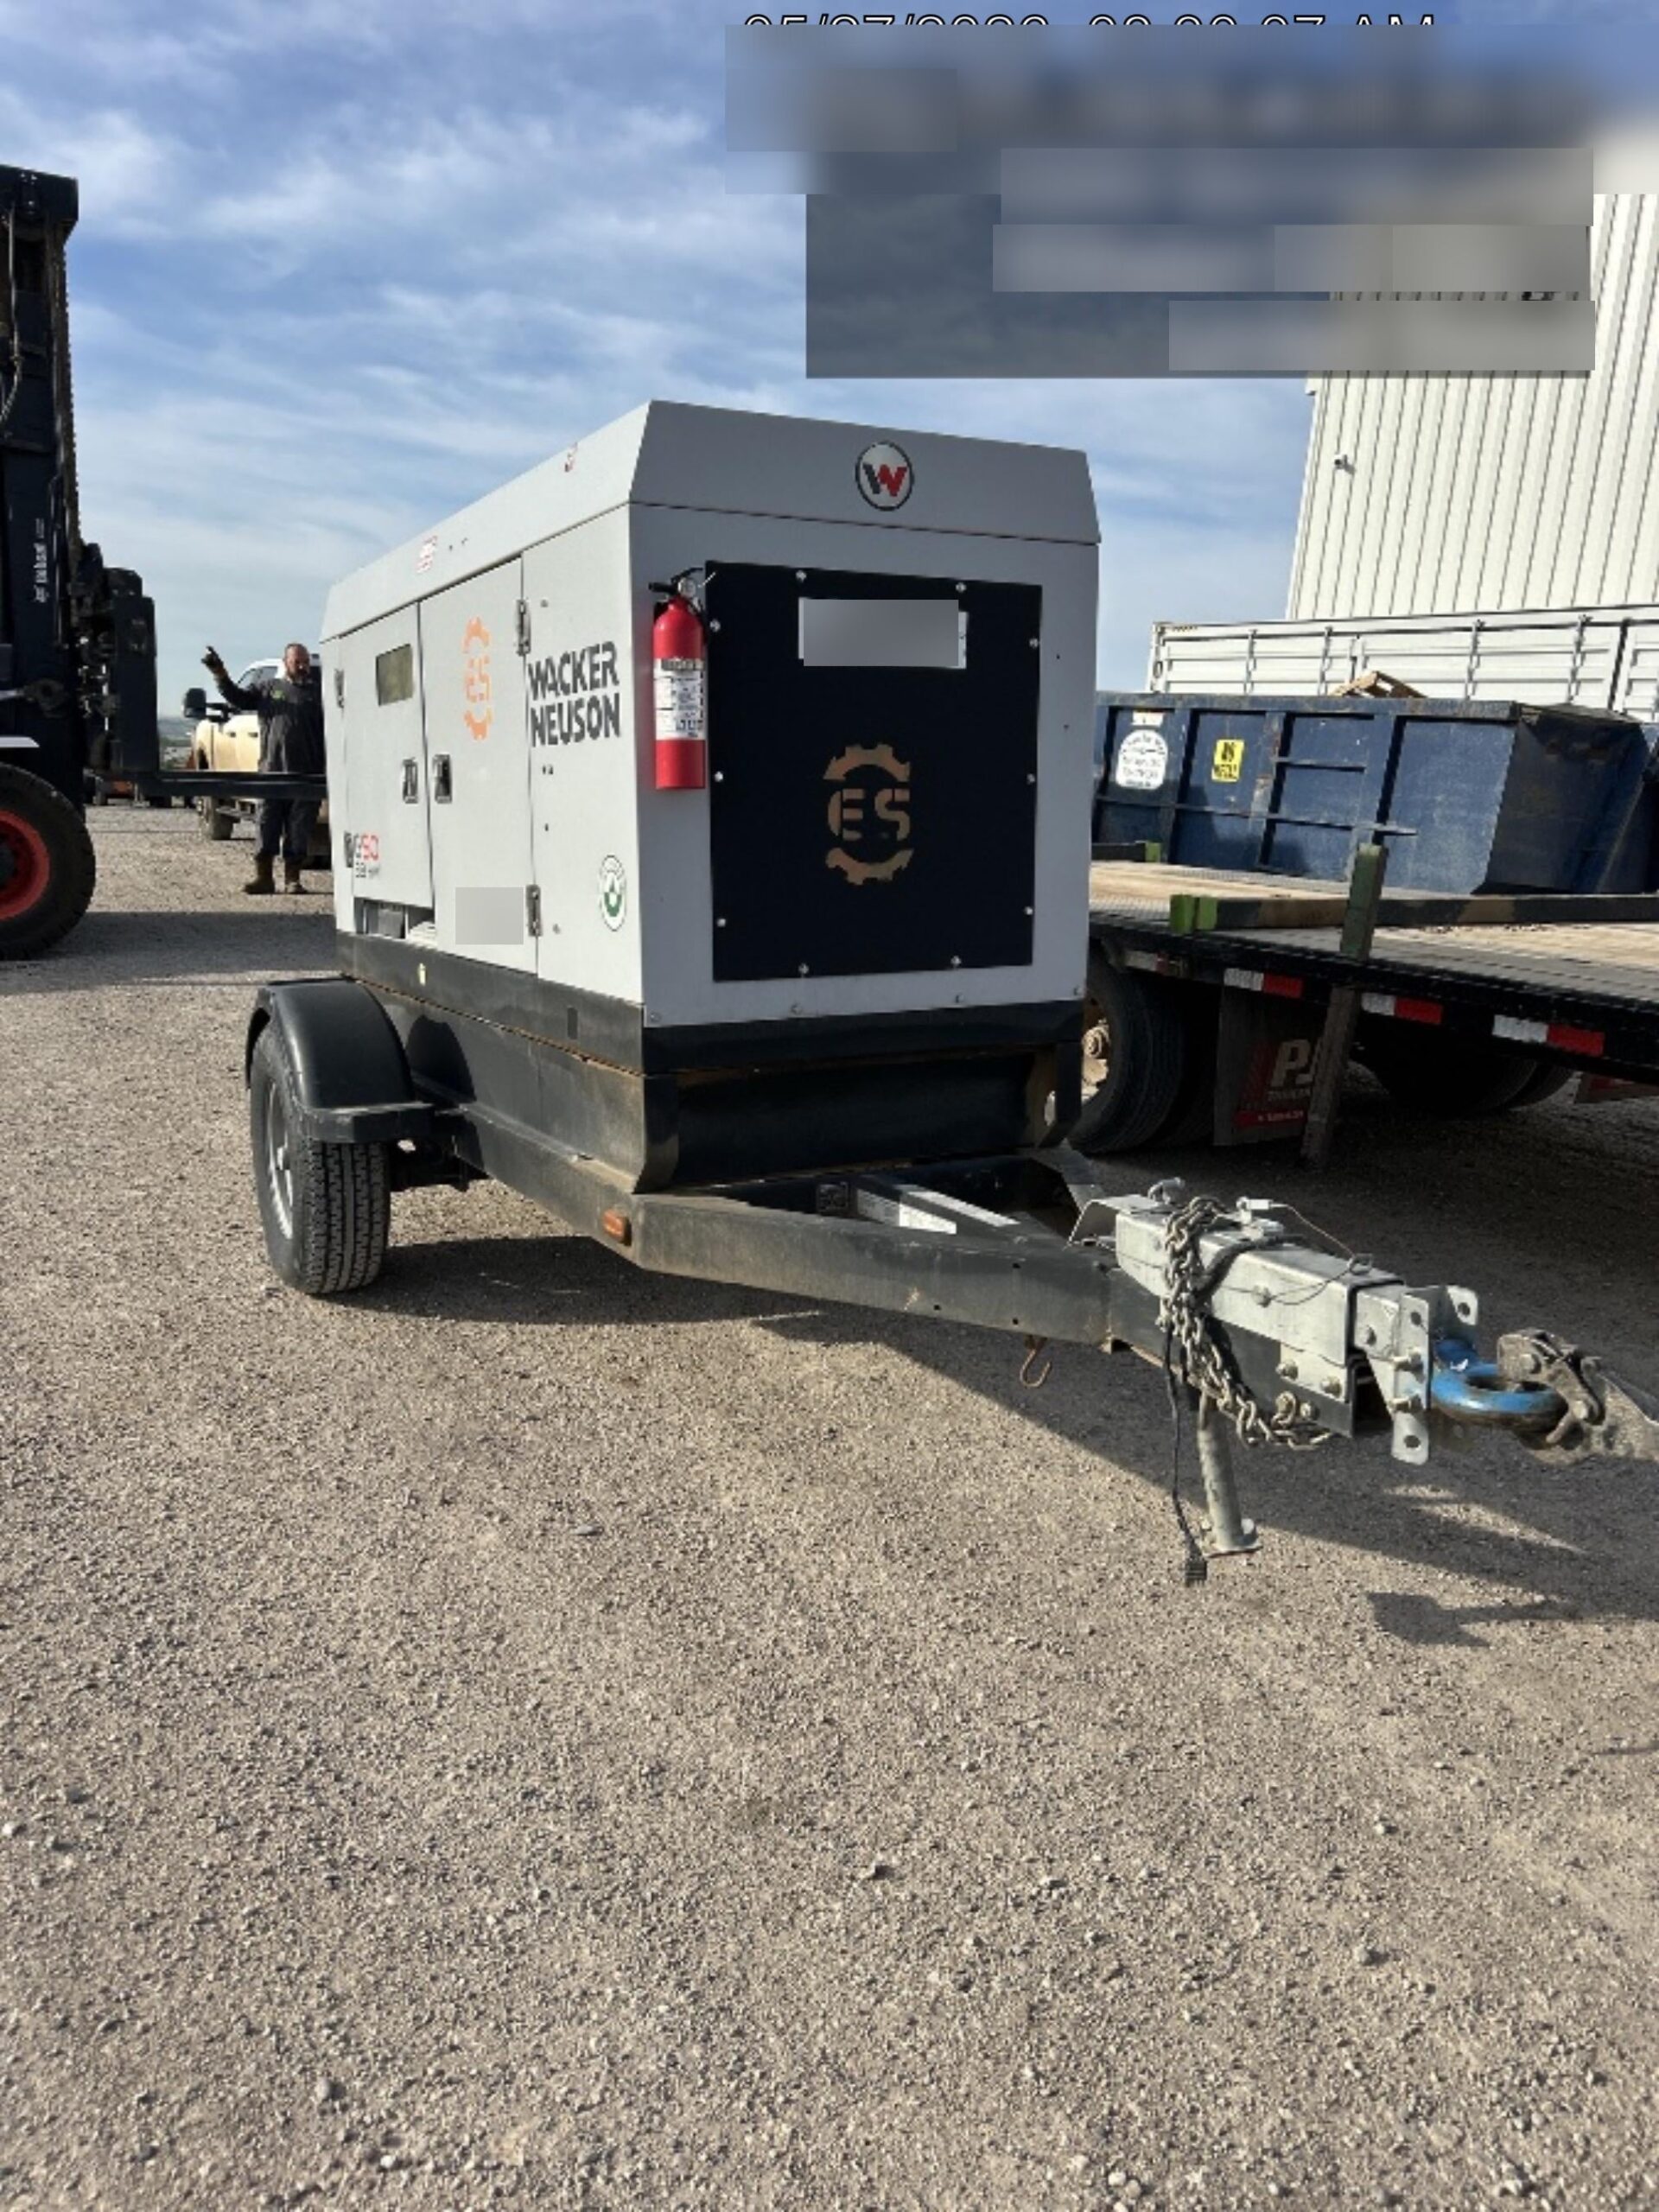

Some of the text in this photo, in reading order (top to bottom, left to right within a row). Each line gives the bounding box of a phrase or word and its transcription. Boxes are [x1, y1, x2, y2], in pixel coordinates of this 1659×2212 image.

[528, 641, 620, 701] WACKER
[531, 692, 620, 747] NEUSON
[827, 787, 911, 842] ES
